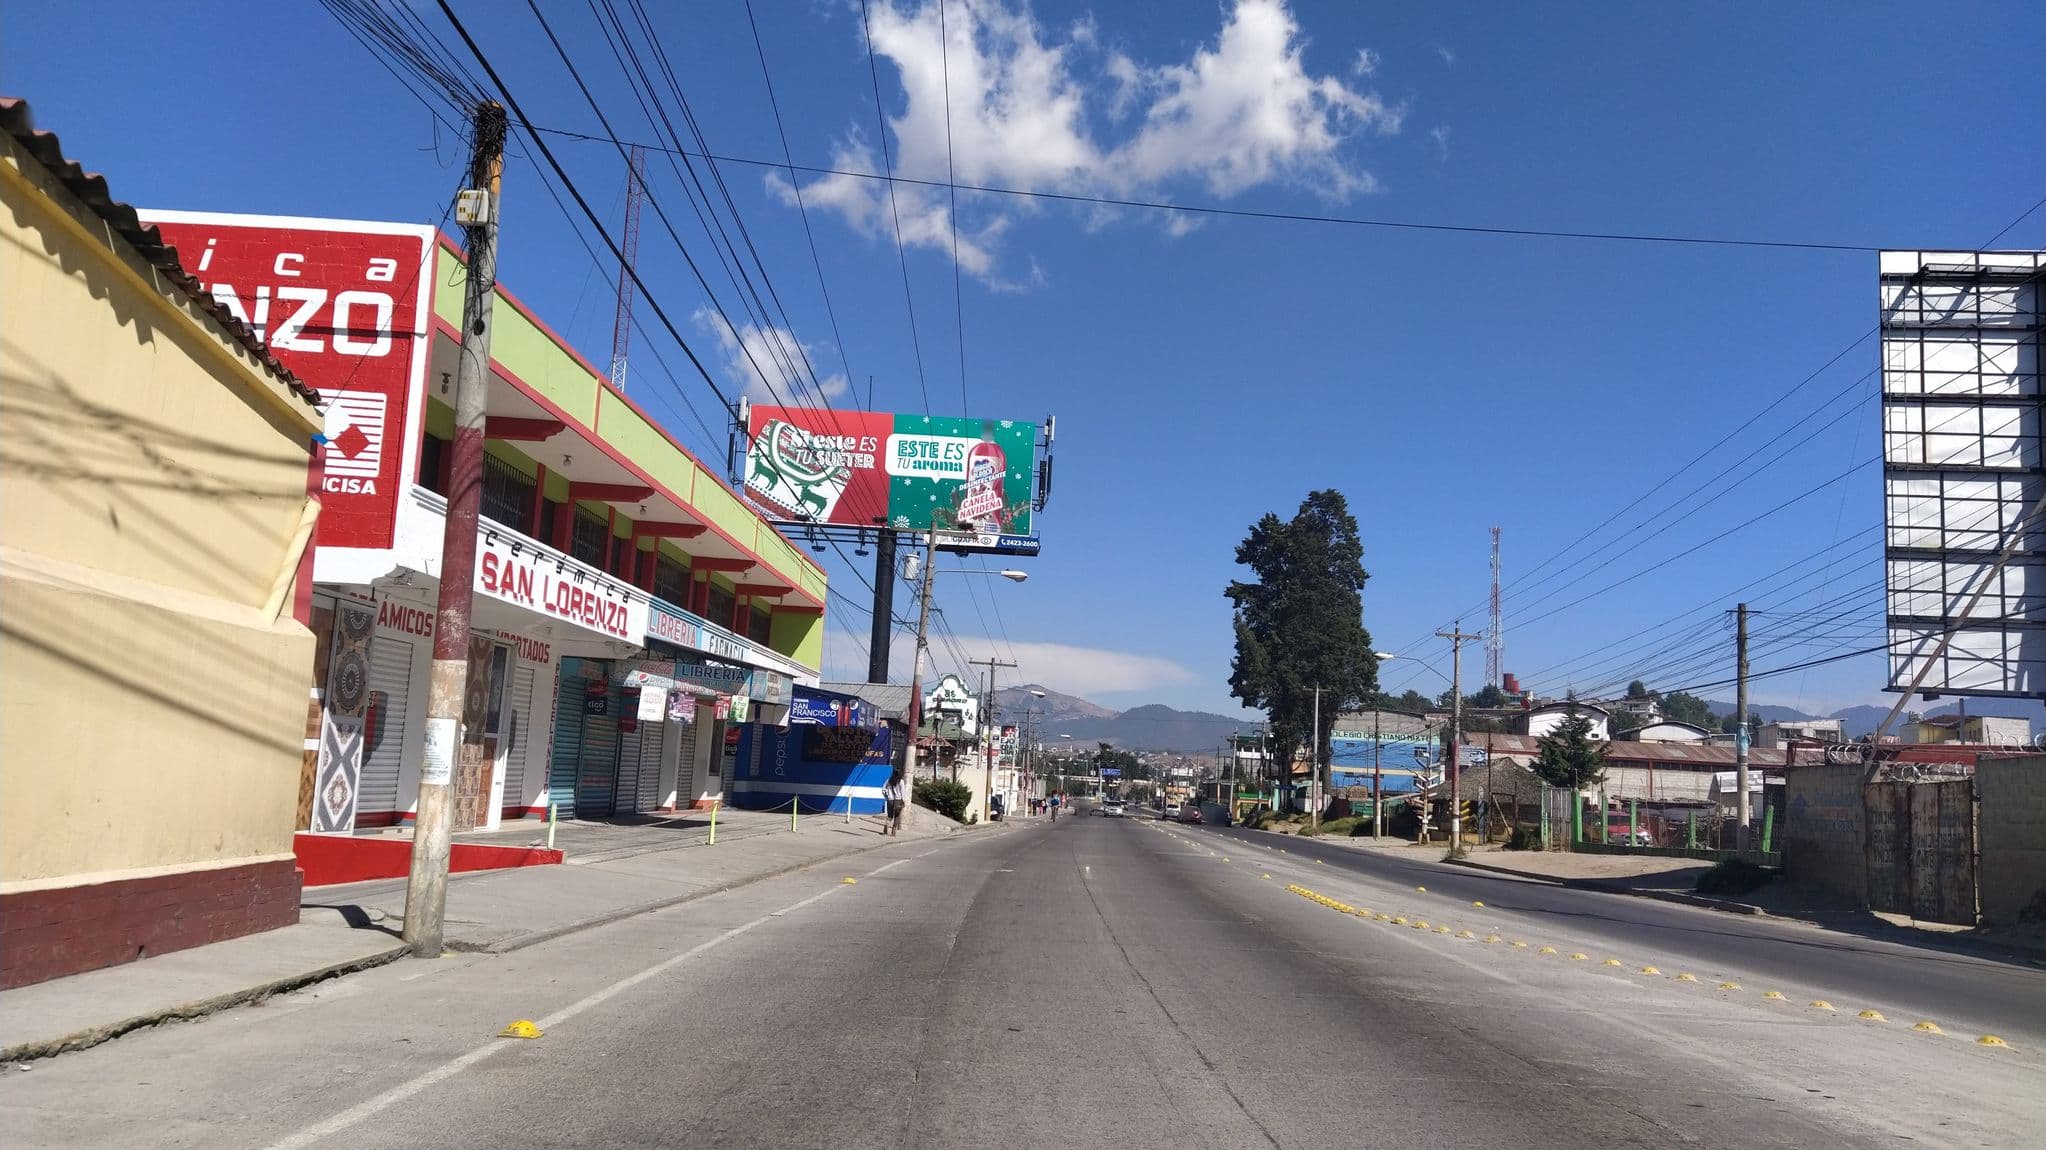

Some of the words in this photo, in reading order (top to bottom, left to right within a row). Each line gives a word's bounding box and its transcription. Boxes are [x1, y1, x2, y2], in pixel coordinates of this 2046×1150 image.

[200, 283, 394, 357] NZO
[813, 434, 856, 450] este
[859, 436, 878, 452] ES
[897, 440, 939, 459] ESTE
[944, 442, 965, 460] ES
[795, 449, 812, 465] TU
[897, 457, 911, 469] TU
[912, 459, 963, 472] aroma
[962, 492, 995, 508] CANELA
[480, 551, 535, 604] SAN
[543, 575, 629, 638] LORENZO
[649, 607, 697, 648] LIBRERIA
[709, 635, 745, 661] FARMACIA
[681, 663, 746, 682] LIBRERIA
[792, 702, 809, 710] SAN
[792, 709, 837, 718] FRANCISCO
[1331, 731, 1362, 739] OLEGIO
[774, 740, 788, 776] pepsi
